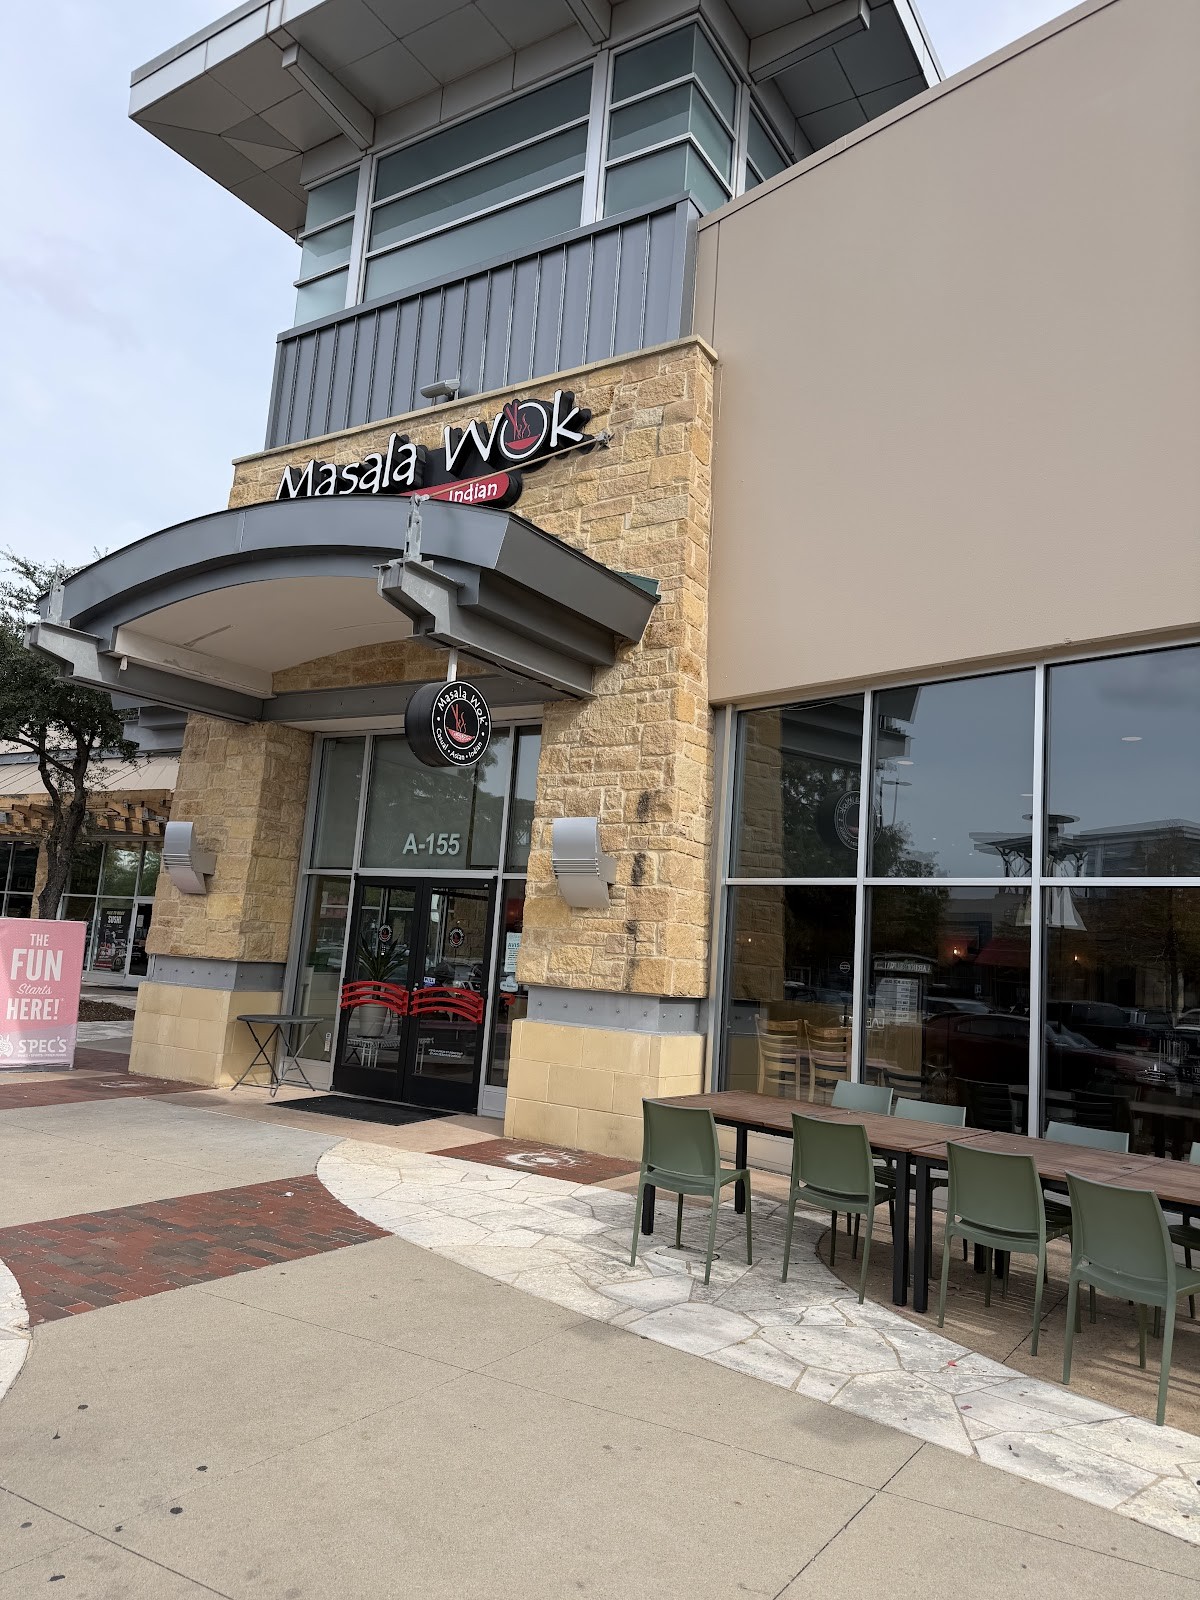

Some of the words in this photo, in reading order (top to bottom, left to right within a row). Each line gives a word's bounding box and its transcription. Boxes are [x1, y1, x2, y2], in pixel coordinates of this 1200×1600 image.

[275, 432, 418, 501] Masala
[449, 482, 498, 504] Indian
[438, 686, 467, 711] Masala
[436, 728, 449, 751] Casual
[450, 751, 466, 760] Asian
[402, 833, 460, 855] A-155
[30, 933, 50, 947] THE
[10, 948, 64, 982] FUN
[16, 983, 53, 996] Starts
[6, 998, 60, 1021] HERE!
[18, 1036, 67, 1053] SPEC'S
